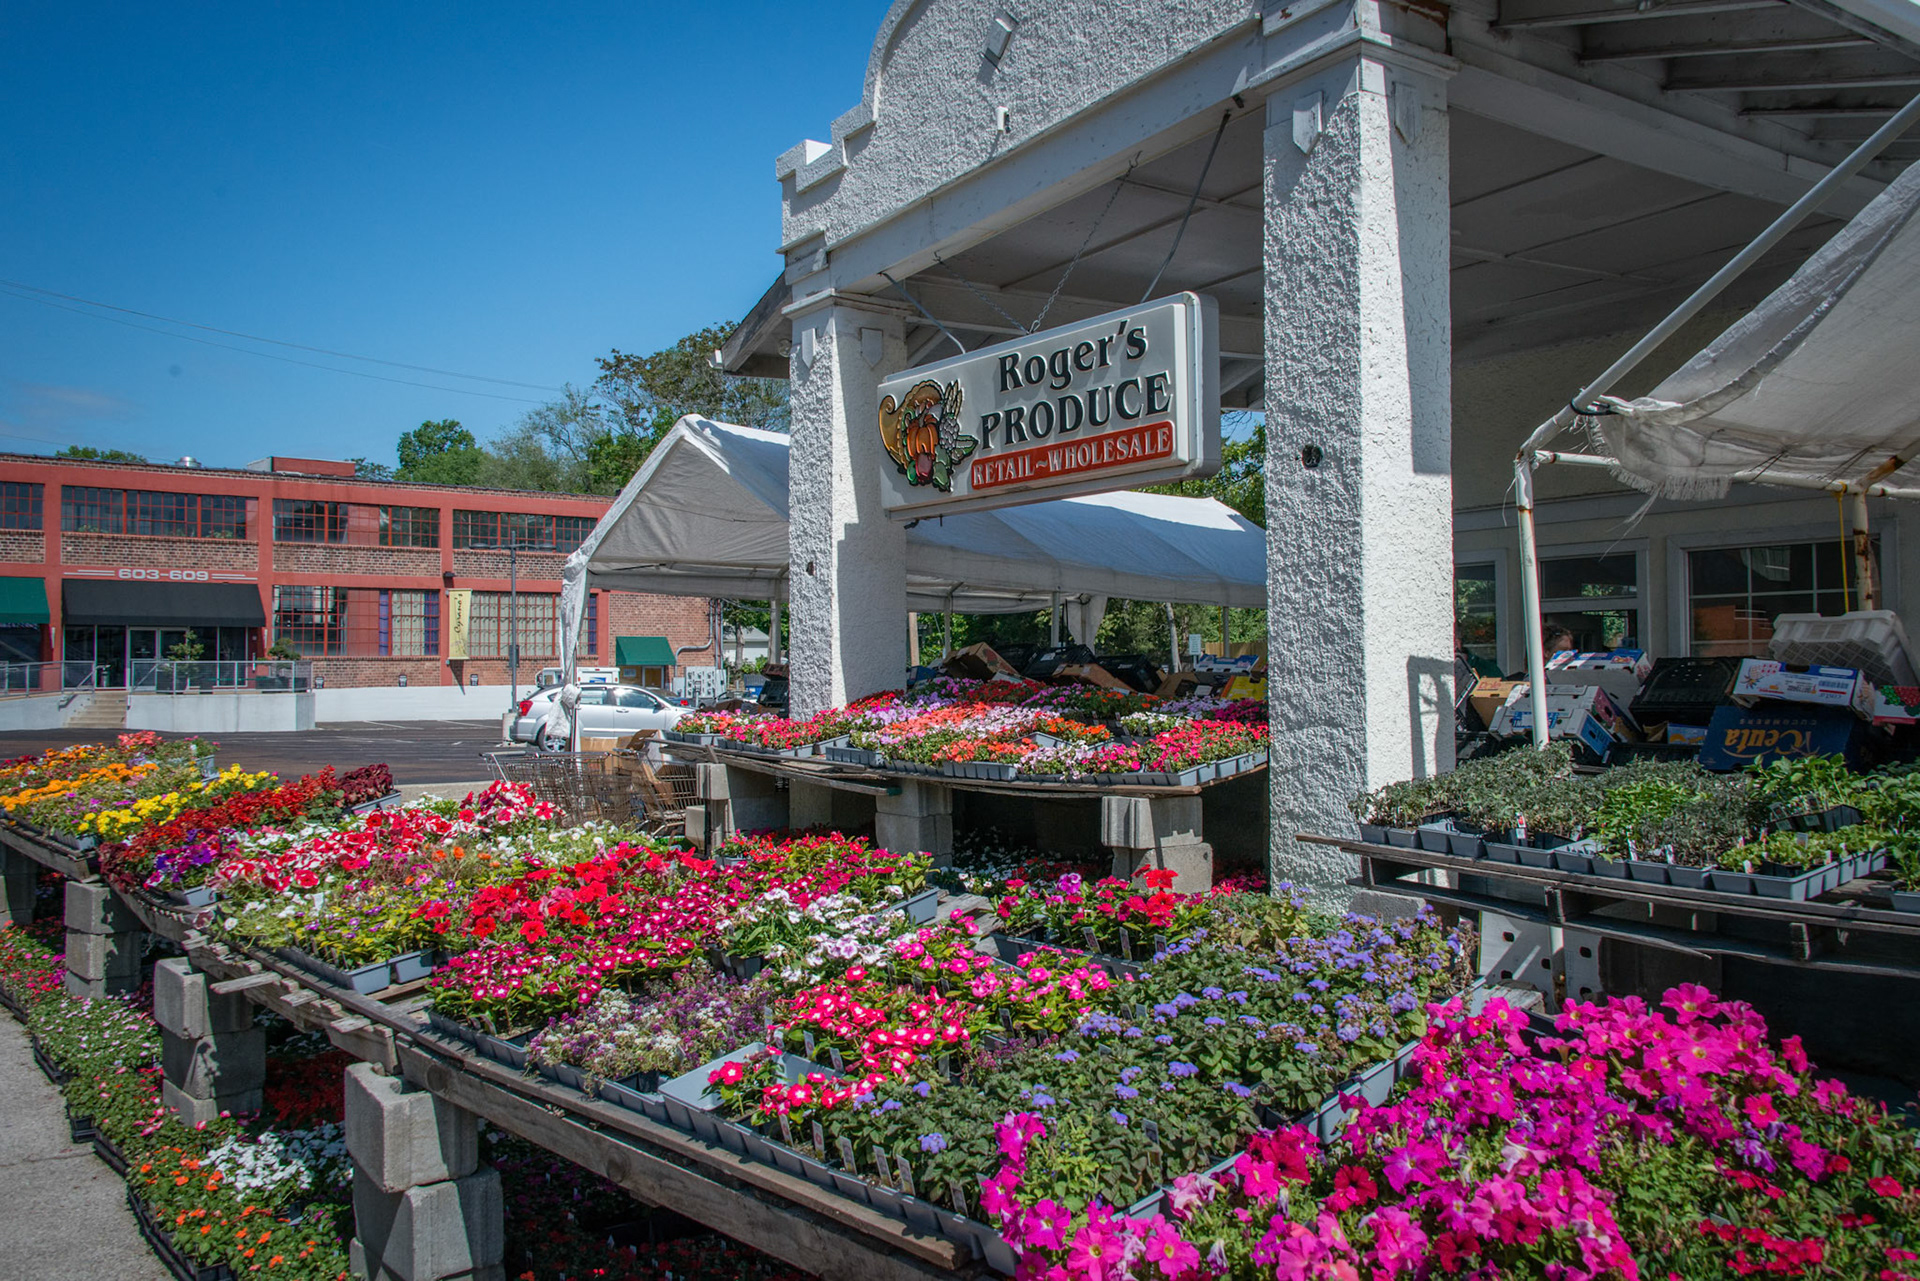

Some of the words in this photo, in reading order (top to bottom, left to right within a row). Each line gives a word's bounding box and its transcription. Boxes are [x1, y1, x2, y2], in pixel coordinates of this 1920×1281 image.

[999, 319, 1148, 392] Roger's
[980, 371, 1173, 450] PRODUCE
[118, 569, 209, 581] 603-609
